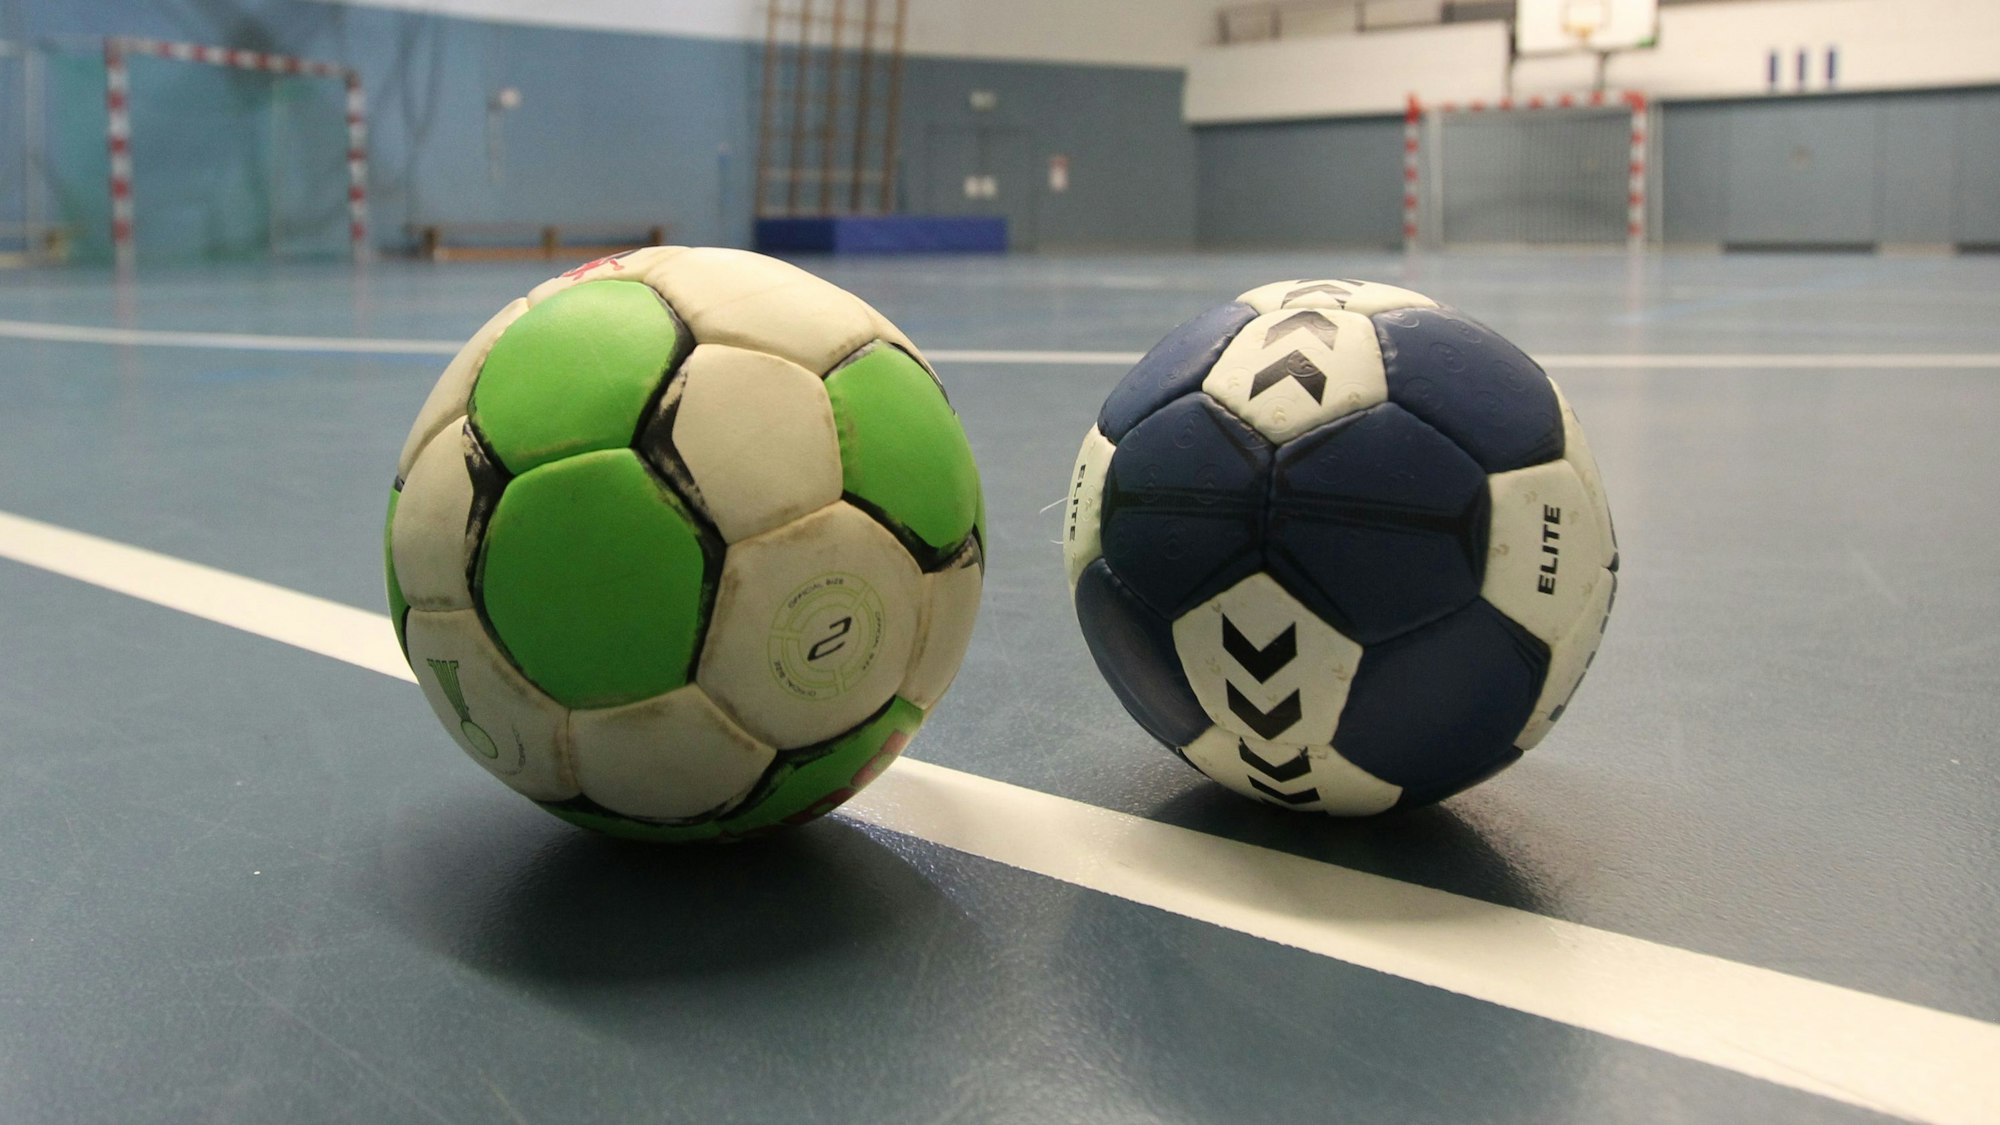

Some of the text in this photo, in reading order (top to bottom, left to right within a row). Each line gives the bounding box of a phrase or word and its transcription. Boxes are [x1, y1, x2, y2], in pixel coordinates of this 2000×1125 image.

[1069, 464, 1086, 542] ELITE
[1537, 504, 1561, 595] ELITE
[807, 616, 852, 661] 2
